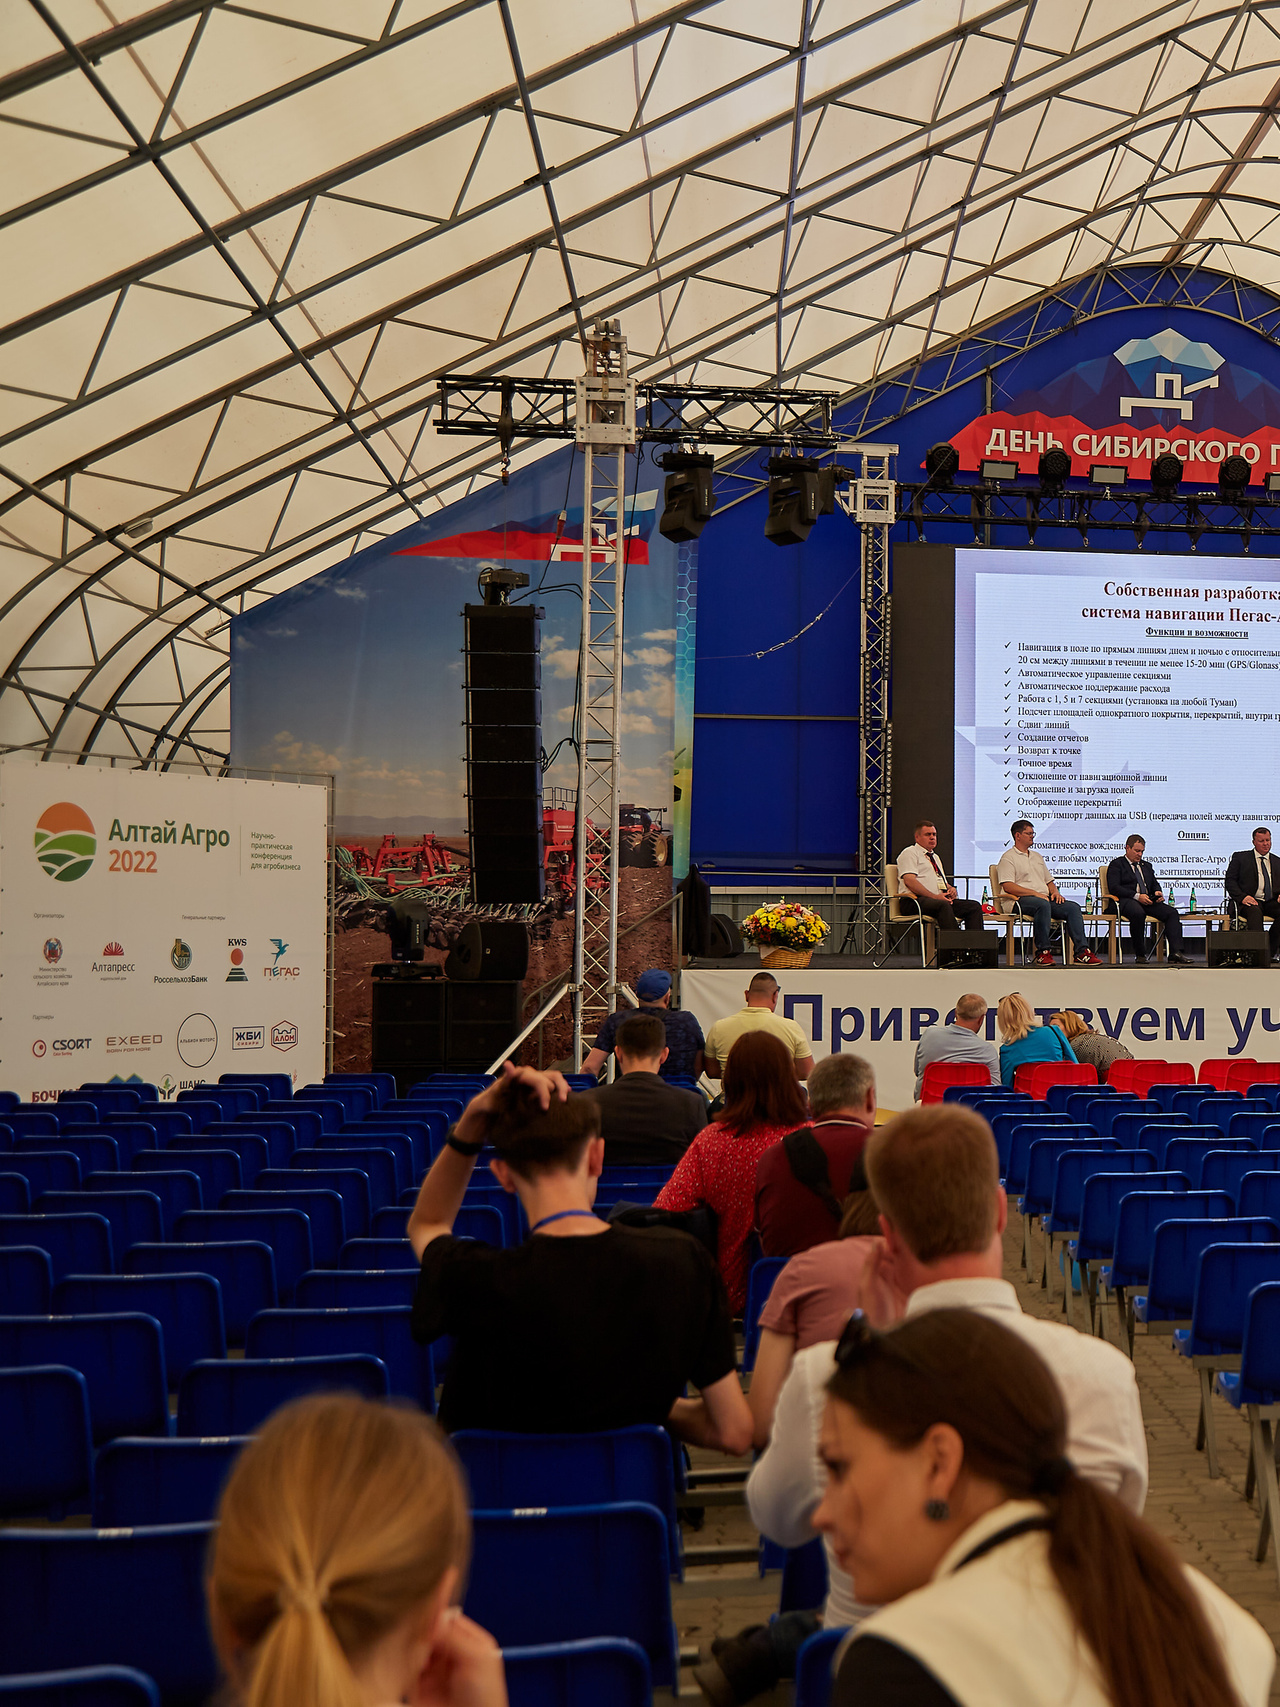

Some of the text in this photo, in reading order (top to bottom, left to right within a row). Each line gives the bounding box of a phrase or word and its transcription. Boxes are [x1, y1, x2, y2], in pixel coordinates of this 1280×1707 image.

[986, 428, 1064, 456] ДЕНЬ
[1072, 434, 1260, 464] СИБИРСКОГО
[1104, 582, 1199, 598] Собственная
[1081, 607, 1140, 619] система
[1145, 609, 1223, 622] навигации
[1145, 627, 1187, 636] Функции
[1195, 630, 1248, 638] возможности
[1018, 642, 1061, 652] Навигация
[1102, 646, 1134, 655] прямым
[1018, 655, 1027, 663] 20
[1042, 658, 1068, 666] между
[1186, 659, 1207, 667] 15-20
[1017, 668, 1171, 680] Автоматическое управление секциями
[1018, 681, 1170, 694] Автоматическое поддержание расхода
[1018, 694, 1045, 702] Работа
[1055, 694, 1061, 704] 1,
[1125, 696, 1168, 707] (установка
[1181, 697, 1207, 705] любой
[1208, 697, 1237, 708] Туман)
[1018, 706, 1051, 716] Подсчет
[1053, 707, 1093, 717] площадей
[1095, 710, 1149, 719] однократного
[1151, 711, 1192, 720] покрытия,
[1194, 710, 1243, 721] перекрытий,
[1245, 713, 1272, 721] внутри
[1018, 720, 1070, 730] Сдвиг линий
[1018, 733, 1056, 742] Создание
[1018, 746, 1050, 756] Возврат
[1018, 759, 1072, 769] Точное время
[1018, 772, 1066, 780] Отклонение
[1079, 772, 1140, 782] навигационной
[1018, 785, 1066, 795] Сохранение
[1075, 787, 1108, 795] загрузка
[1110, 786, 1134, 794] полей
[1017, 798, 1121, 808] Отображение перекрытий
[1018, 810, 1083, 821] Экспорт/импорт
[1085, 812, 1115, 820] данных
[1128, 811, 1146, 820] USB
[1148, 812, 1187, 822] (передача
[1189, 812, 1212, 820] полей
[1214, 814, 1240, 822] между
[108, 819, 230, 852] Алтай Агро
[251, 832, 276, 840] Научно-
[1178, 831, 1210, 839] Опции:
[251, 842, 293, 850] практическая
[108, 849, 157, 873] 2022
[251, 852, 292, 861] конференция
[1058, 854, 1087, 862] любым
[1181, 855, 1226, 865] Пегас-Агро
[263, 863, 301, 871] агробизнеса
[1160, 868, 1220, 878] вентиляторный
[1163, 880, 1190, 888] любых
[92, 962, 135, 974] Алтапресс
[264, 966, 300, 977] ПЕГАС
[154, 975, 207, 983] РоссельхозБанк
[784, 994, 1205, 1053] Привттвуем
[106, 1035, 162, 1046] EXEED
[236, 1031, 261, 1041] ЖБИ
[53, 1038, 92, 1050] CSORT
